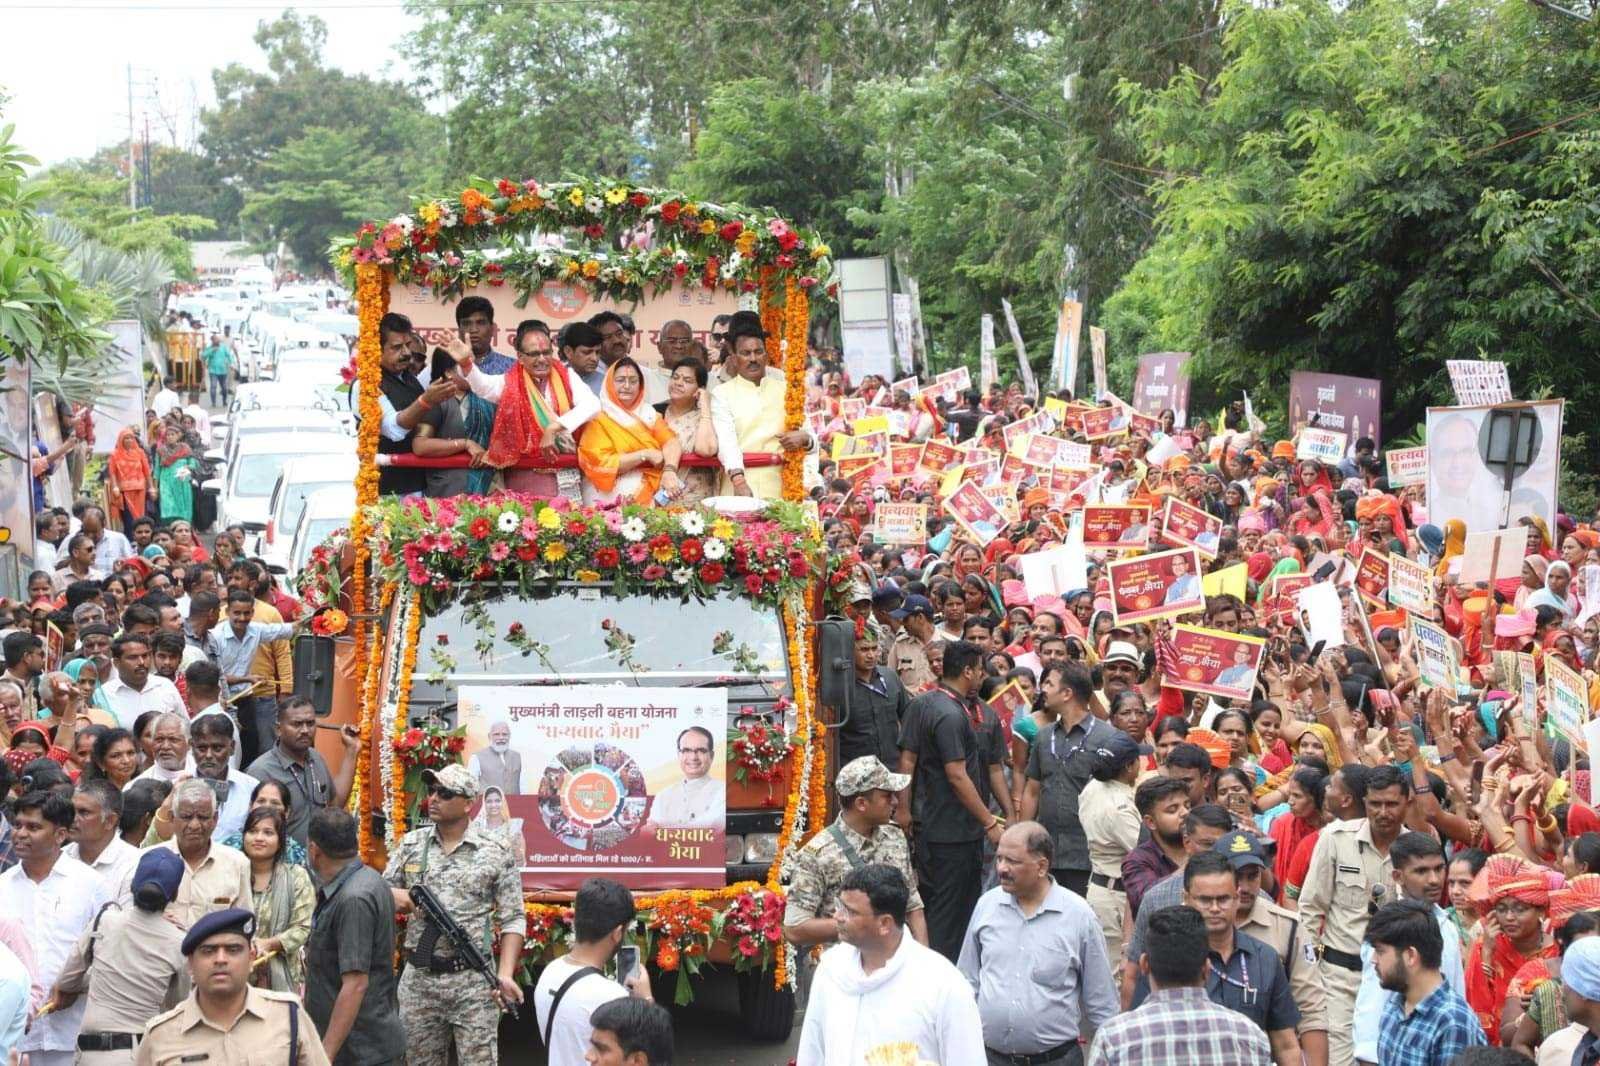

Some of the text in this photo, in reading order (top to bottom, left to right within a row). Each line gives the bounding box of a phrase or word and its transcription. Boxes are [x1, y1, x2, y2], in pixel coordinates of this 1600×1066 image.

[509, 703, 677, 721] मुख्यमंत्री लाड़ली बहना योजना
[656, 827, 714, 842] धन्यवाद
[669, 841, 701, 860] भैया
